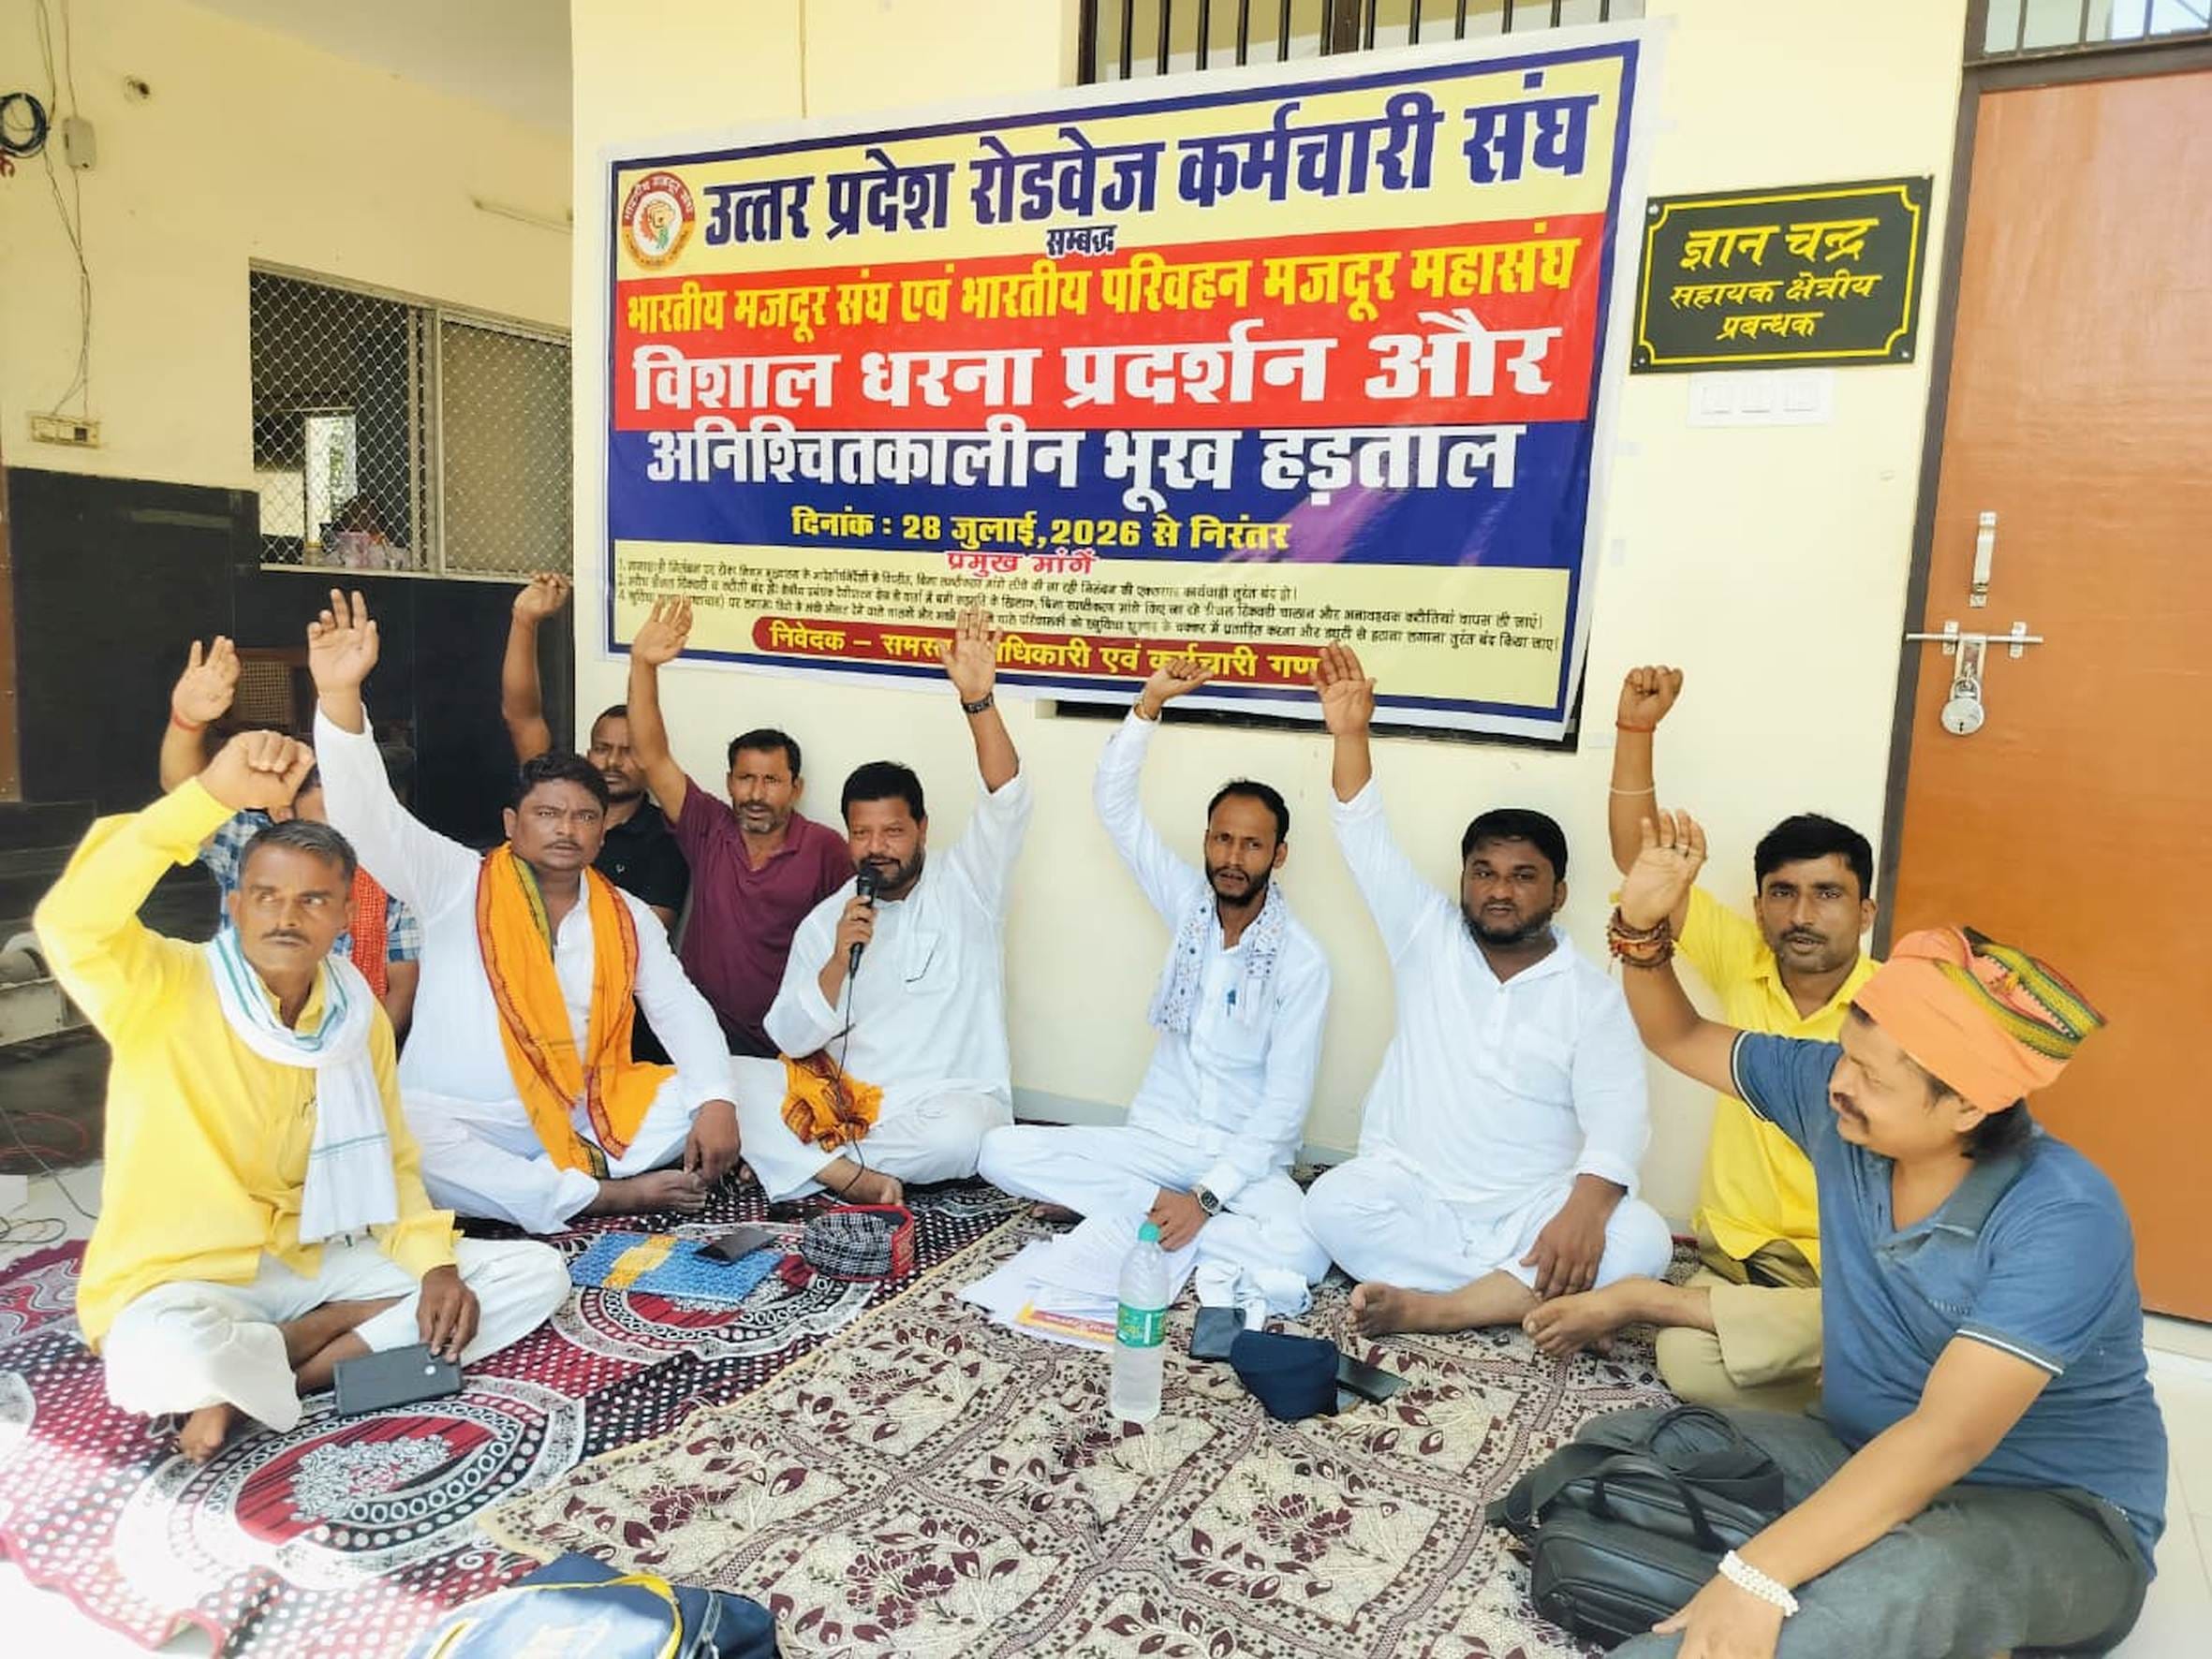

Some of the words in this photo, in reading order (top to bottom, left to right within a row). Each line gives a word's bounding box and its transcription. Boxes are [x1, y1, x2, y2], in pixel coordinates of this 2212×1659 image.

[703, 175, 814, 246] उत्तर
[826, 148, 955, 241] प्रदेश
[969, 127, 1166, 225] रोडवेज
[1177, 91, 1445, 208] कर्मचारी
[1463, 71, 1600, 184] संघ
[1046, 225, 1118, 258] सम्बद्ध
[1680, 225, 1781, 271] ज्ञान
[1785, 217, 1880, 262] चन्द्र
[627, 281, 726, 334] भारतीय
[734, 285, 831, 343] मजदूर
[836, 268, 892, 325] संघ
[900, 263, 955, 322] एवं
[961, 258, 1092, 319] भारतीय
[1101, 252, 1252, 316] परिवहन
[1262, 251, 1402, 322] मजदूर
[1410, 222, 1583, 299] महासंघ
[1670, 280, 1784, 310] सहायक
[1785, 268, 1882, 301] क्षेत्रीय
[1716, 311, 1825, 341] प्रबन्धक
[633, 345, 841, 410] विशाल
[860, 348, 1042, 407] धरना
[1061, 318, 1337, 409] प्रदर्शन
[1364, 307, 1563, 400] और
[647, 415, 1085, 488] अनिश्चितकालीन
[1104, 427, 1243, 513] भूख
[1260, 425, 1526, 506] हड़ताल
[791, 505, 875, 537] दिनांक
[902, 514, 941, 540] 28
[1152, 513, 1181, 549] से
[1190, 512, 1291, 551] निरंतर
[945, 551, 1023, 577] प्रमुख
[769, 619, 847, 651] निवेदक
[993, 634, 1092, 668] ाधिकारी
[1099, 643, 1141, 674] एवं
[1268, 654, 1320, 679] गण
